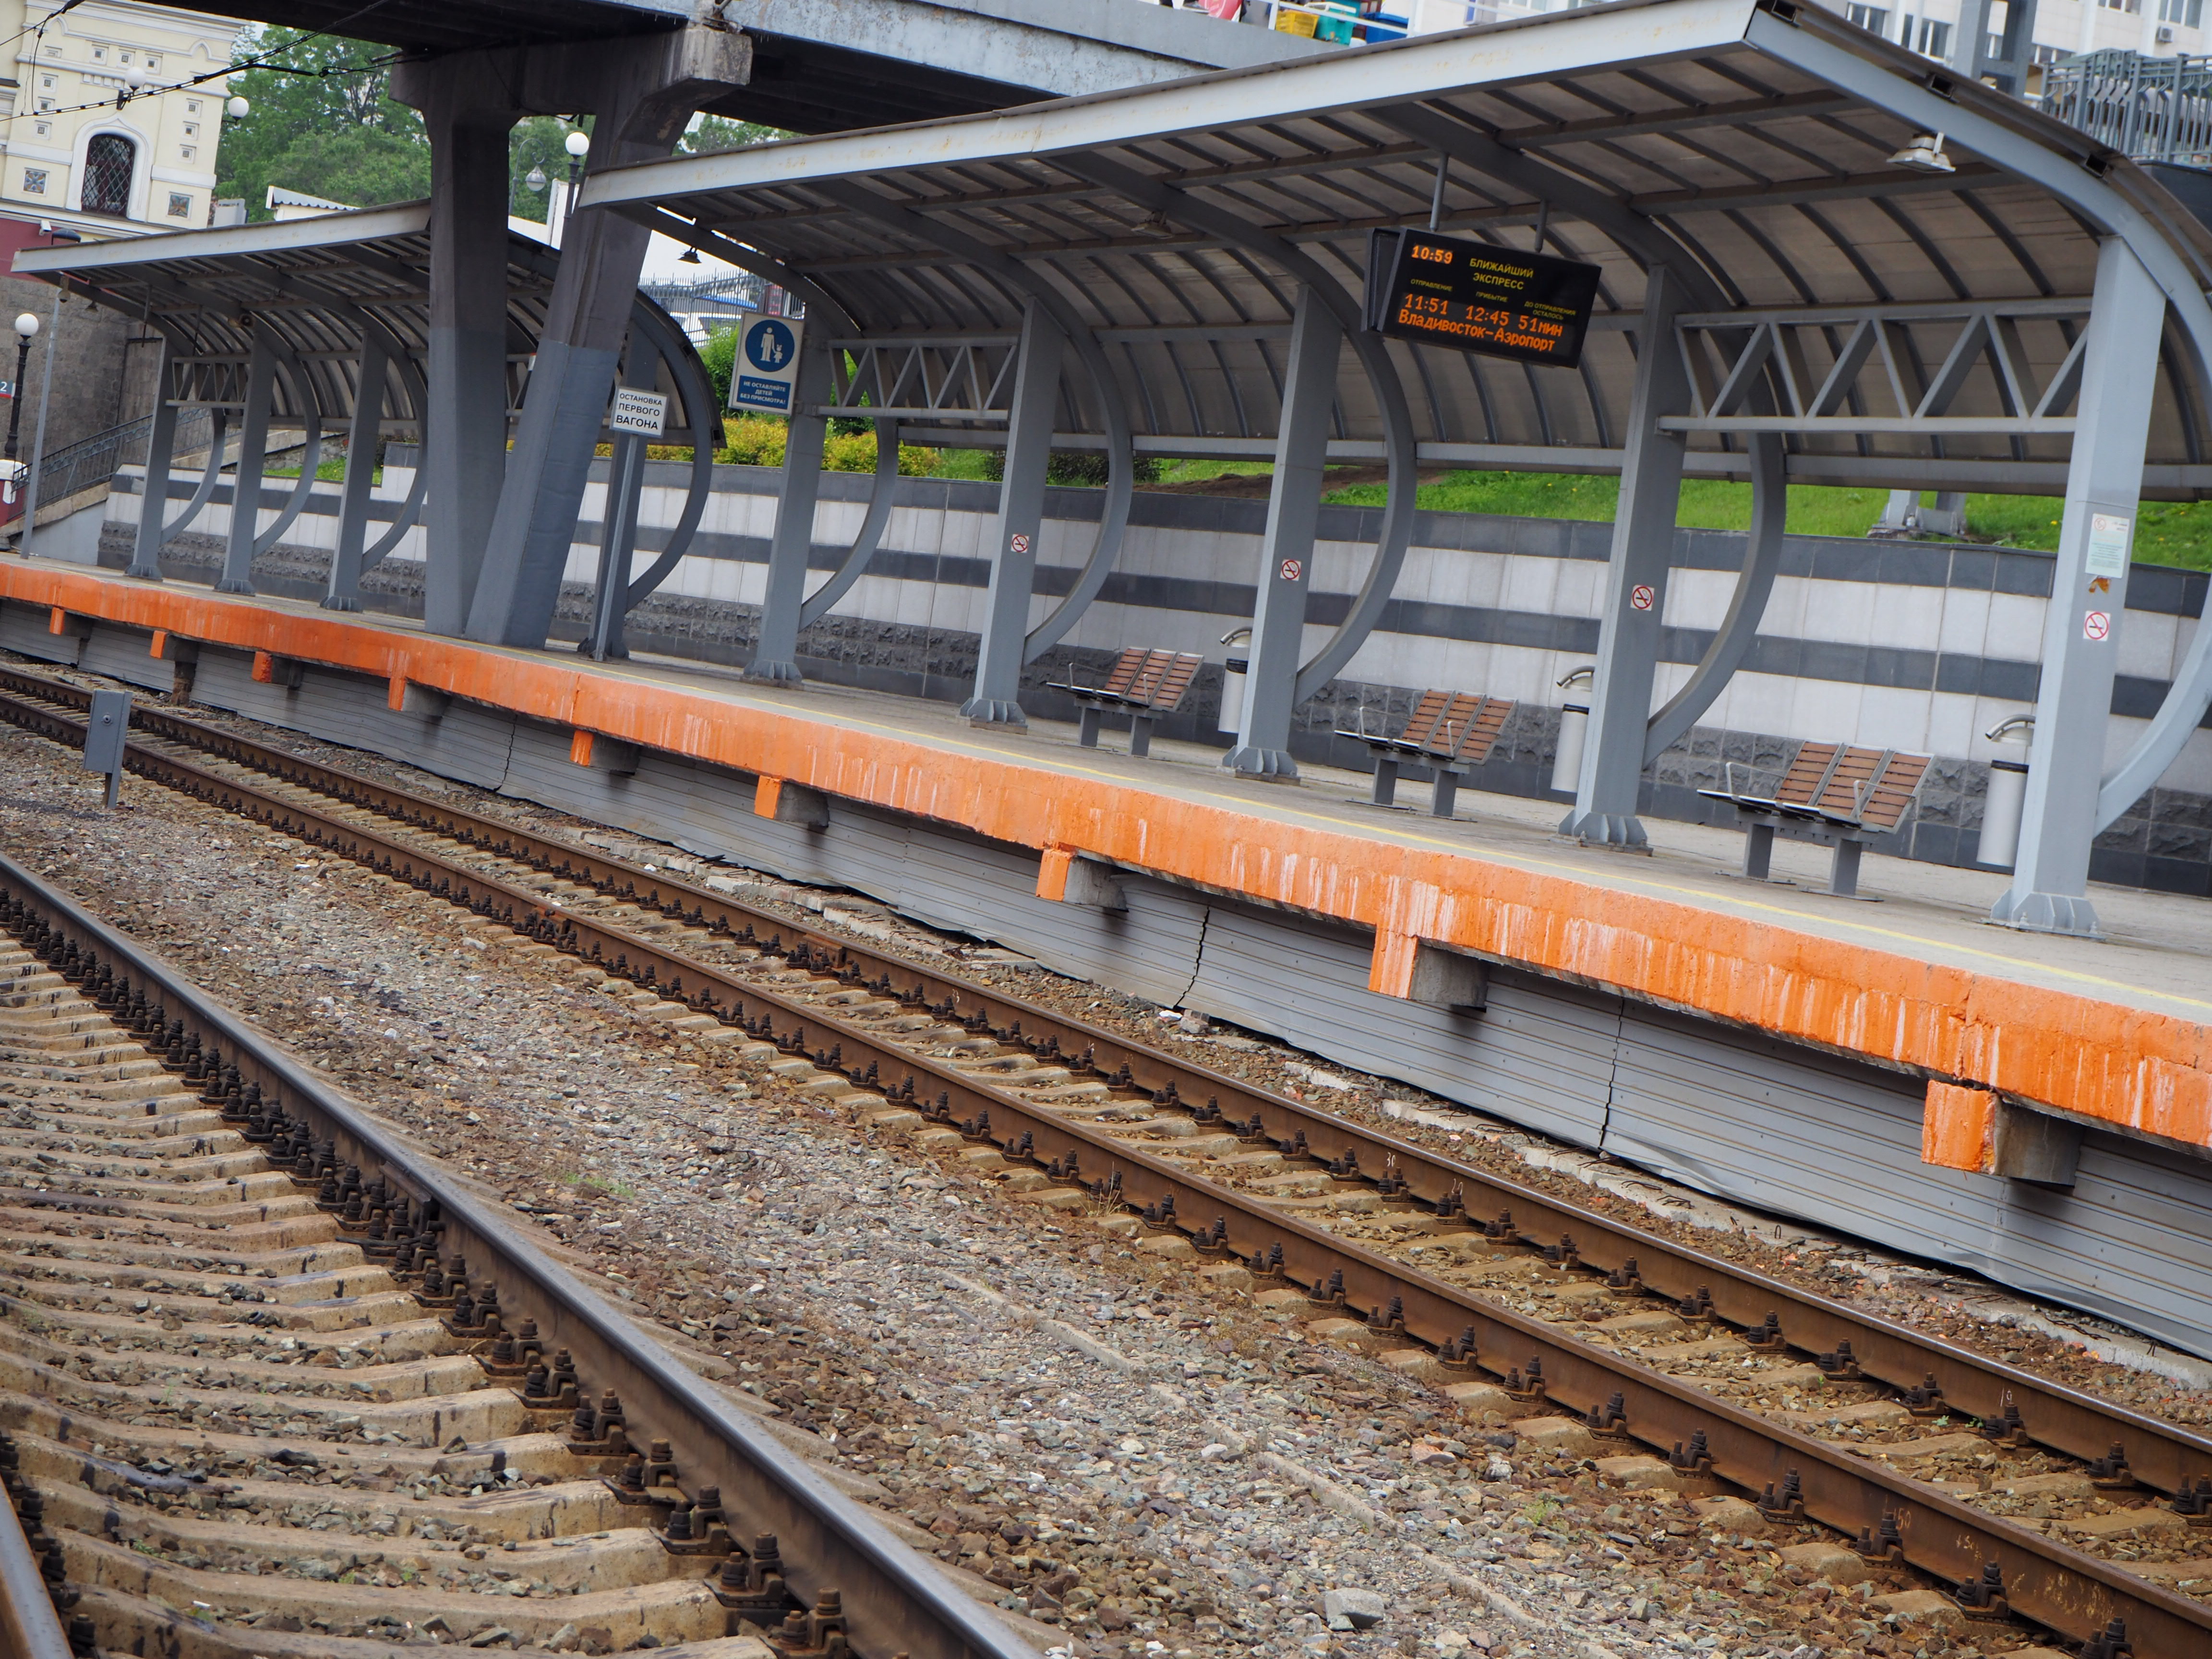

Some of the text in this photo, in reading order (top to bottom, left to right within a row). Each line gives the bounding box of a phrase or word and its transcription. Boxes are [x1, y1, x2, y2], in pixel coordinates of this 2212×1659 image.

[1411, 245, 1453, 264] 10:59
[1469, 258, 1534, 278] БЛИЖАЙШИЙ
[1410, 278, 1453, 292] ОТПРАВЛЕНИЕ
[1473, 273, 1524, 290] ЭКСПРЕСС
[1476, 291, 1508, 302] ПРИБЫТИЕ
[1405, 294, 1448, 315] 11:51
[1466, 305, 1510, 326] 12:45
[1533, 310, 1563, 320] ОСТАЛОСЬ
[1534, 303, 1576, 315] ОТПРАВЛЕНИЯ
[752, 382, 786, 392] ОСТАВЛЯЙТЕ
[620, 393, 661, 405] ОСТАНОВКА
[751, 395, 785, 404] ПРИСМОТРА!
[619, 403, 660, 416] ПЕРВОГО
[616, 415, 658, 430] ВАГОНА
